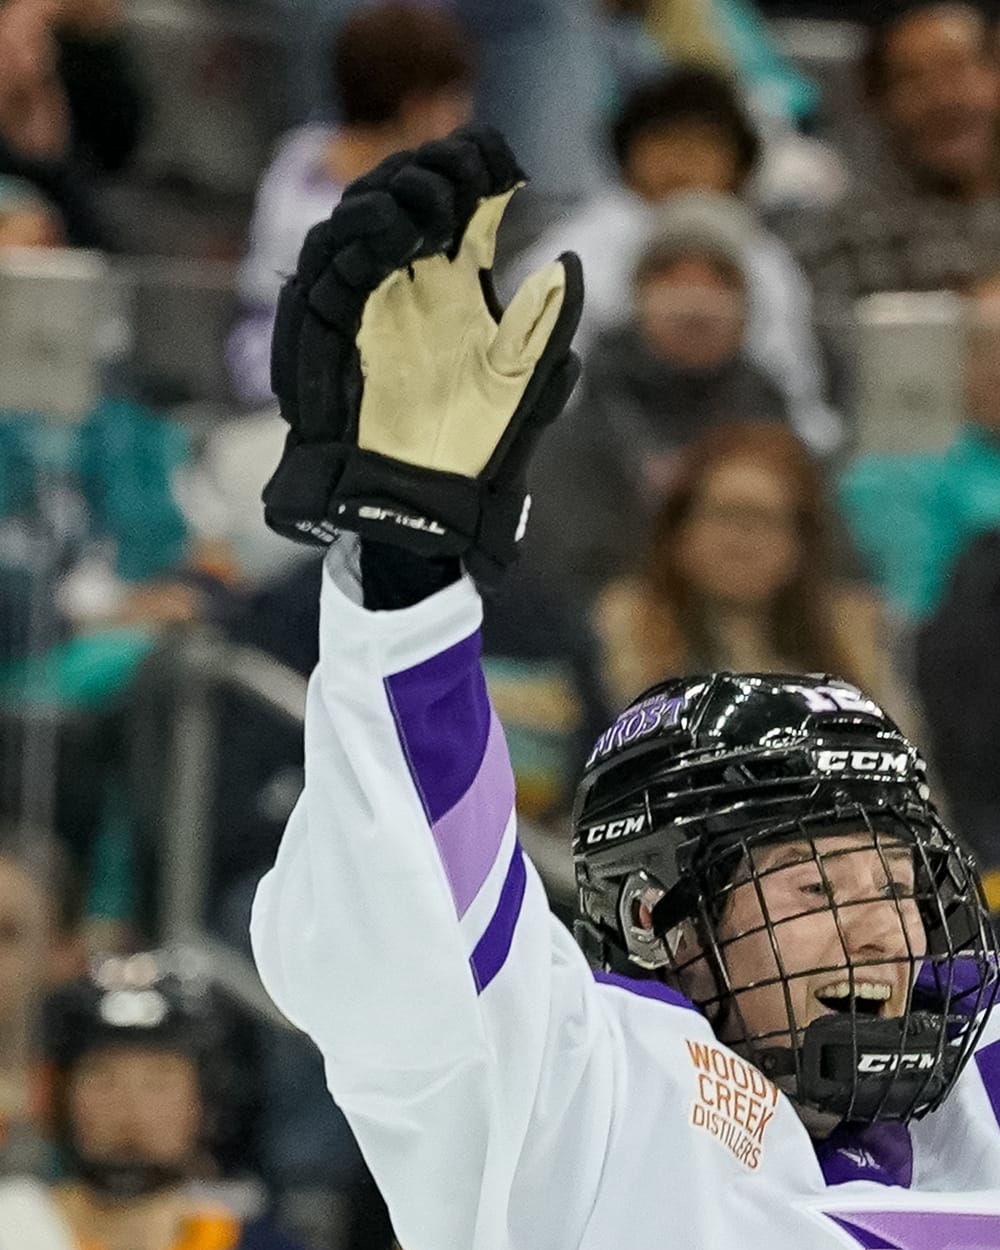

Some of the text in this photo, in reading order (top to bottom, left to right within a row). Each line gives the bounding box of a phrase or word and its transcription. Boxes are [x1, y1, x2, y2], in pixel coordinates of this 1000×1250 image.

[816, 751, 908, 773] CCM
[586, 814, 646, 845] CCM
[857, 1053, 940, 1072] CCM
[698, 1073, 774, 1144] CREEK
[692, 1103, 761, 1169] DISTILLERS
